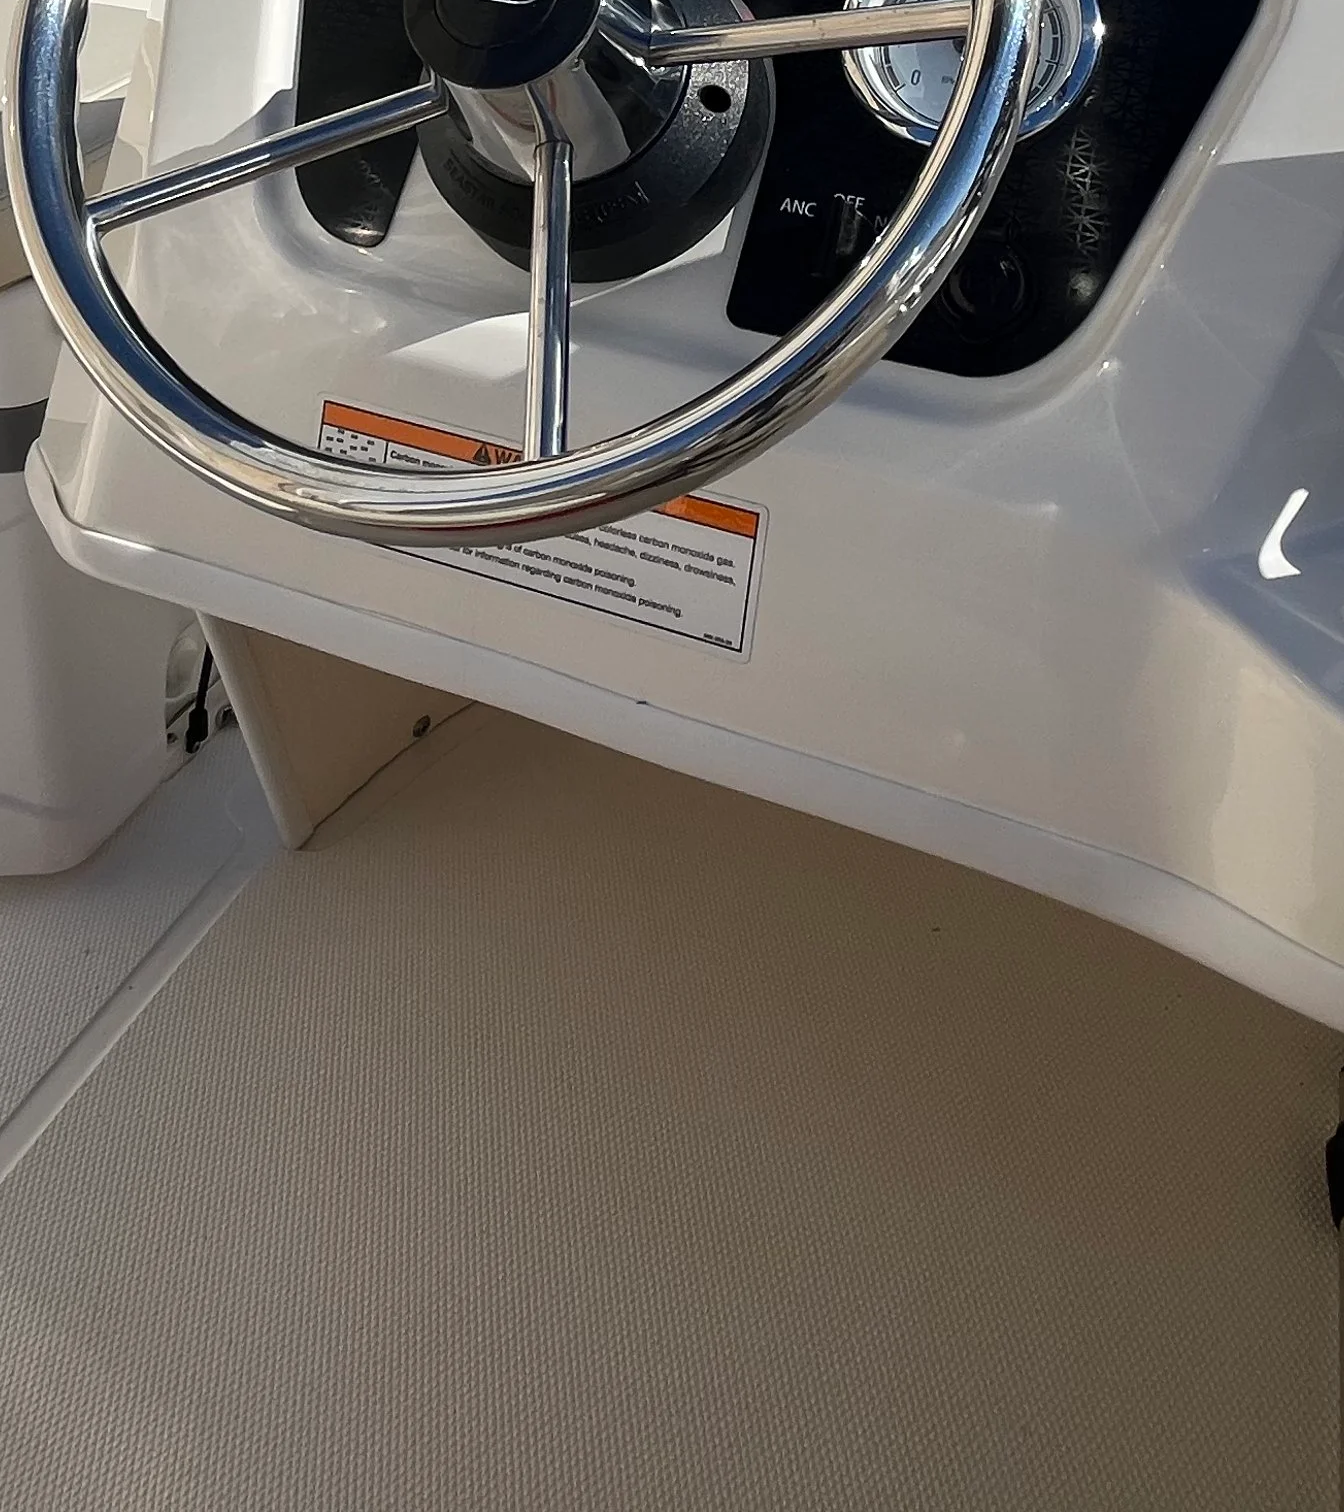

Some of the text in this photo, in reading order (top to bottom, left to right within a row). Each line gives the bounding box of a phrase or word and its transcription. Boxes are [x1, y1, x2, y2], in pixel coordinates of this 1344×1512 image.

[911, 69, 921, 86] 0
[779, 197, 817, 217] ANC
[390, 450, 421, 465] Carbon
